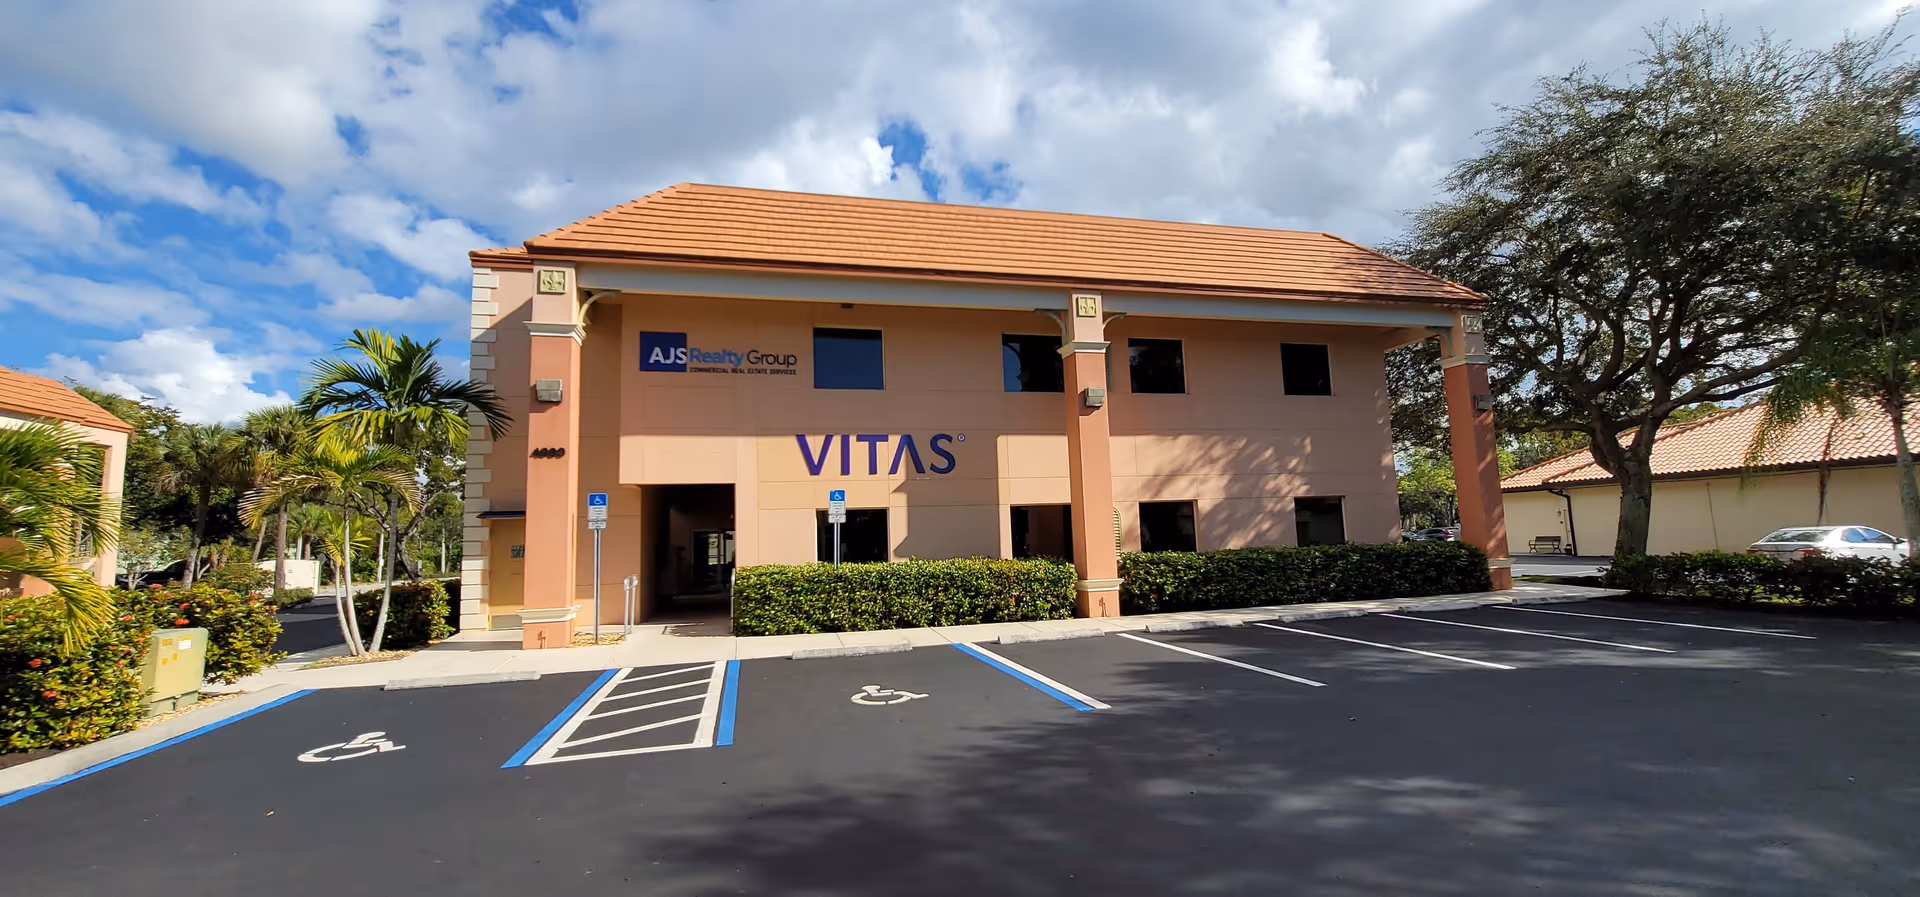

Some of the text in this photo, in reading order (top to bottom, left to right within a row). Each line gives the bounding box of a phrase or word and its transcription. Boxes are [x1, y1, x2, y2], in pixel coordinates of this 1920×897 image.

[649, 347, 798, 368] AJS Realty Group
